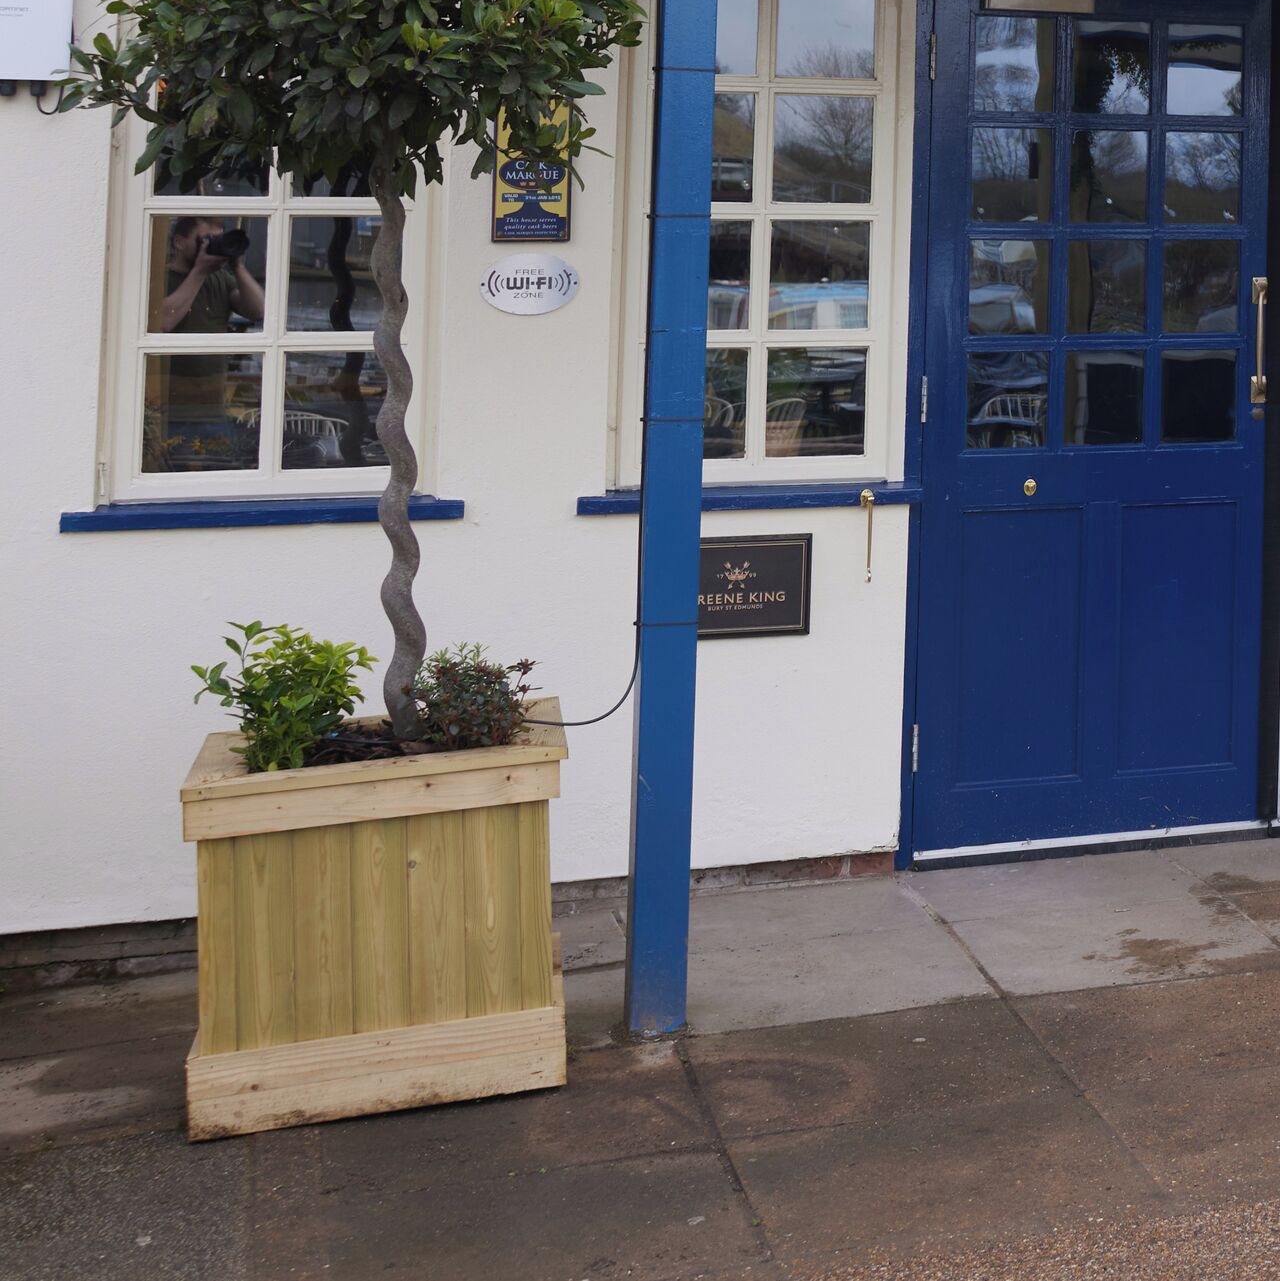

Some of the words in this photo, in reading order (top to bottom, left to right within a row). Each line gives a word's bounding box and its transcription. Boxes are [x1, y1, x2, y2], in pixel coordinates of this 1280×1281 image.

[515, 160, 548, 170] CK
[505, 170, 559, 180] MARUE
[698, 593, 743, 605] REENE
[749, 591, 786, 603] KING
